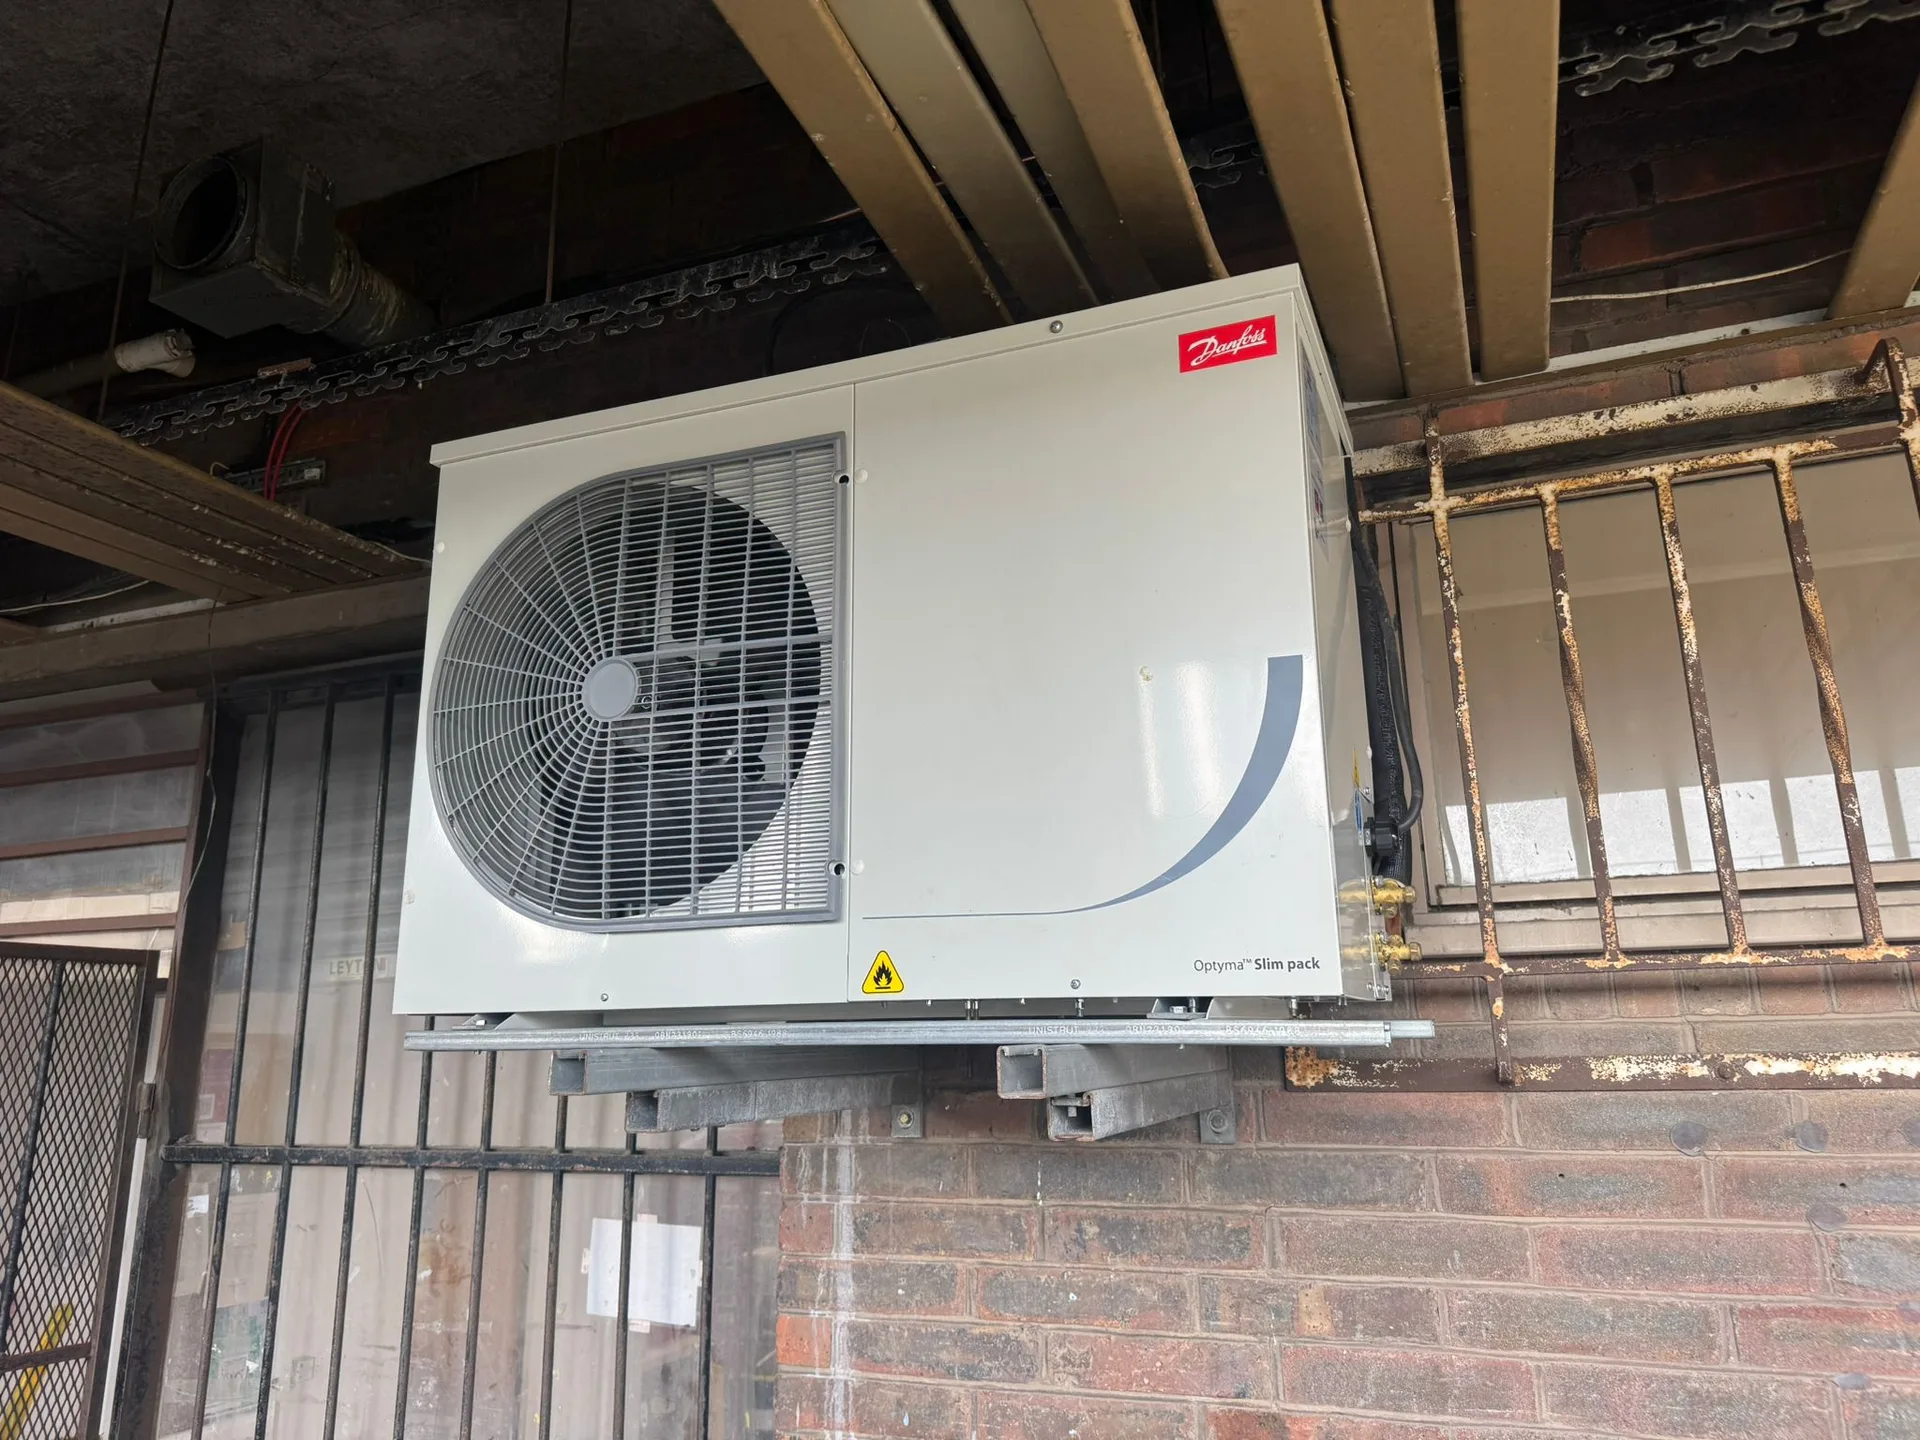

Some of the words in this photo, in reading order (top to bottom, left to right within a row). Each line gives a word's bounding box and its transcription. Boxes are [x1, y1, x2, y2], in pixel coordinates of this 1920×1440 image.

[1188, 323, 1268, 366] Danfoss
[329, 956, 387, 975] LEYTN
[1254, 957, 1284, 970] Slim
[1287, 956, 1320, 973] pack
[1028, 1025, 1079, 1035] UNISTRUT
